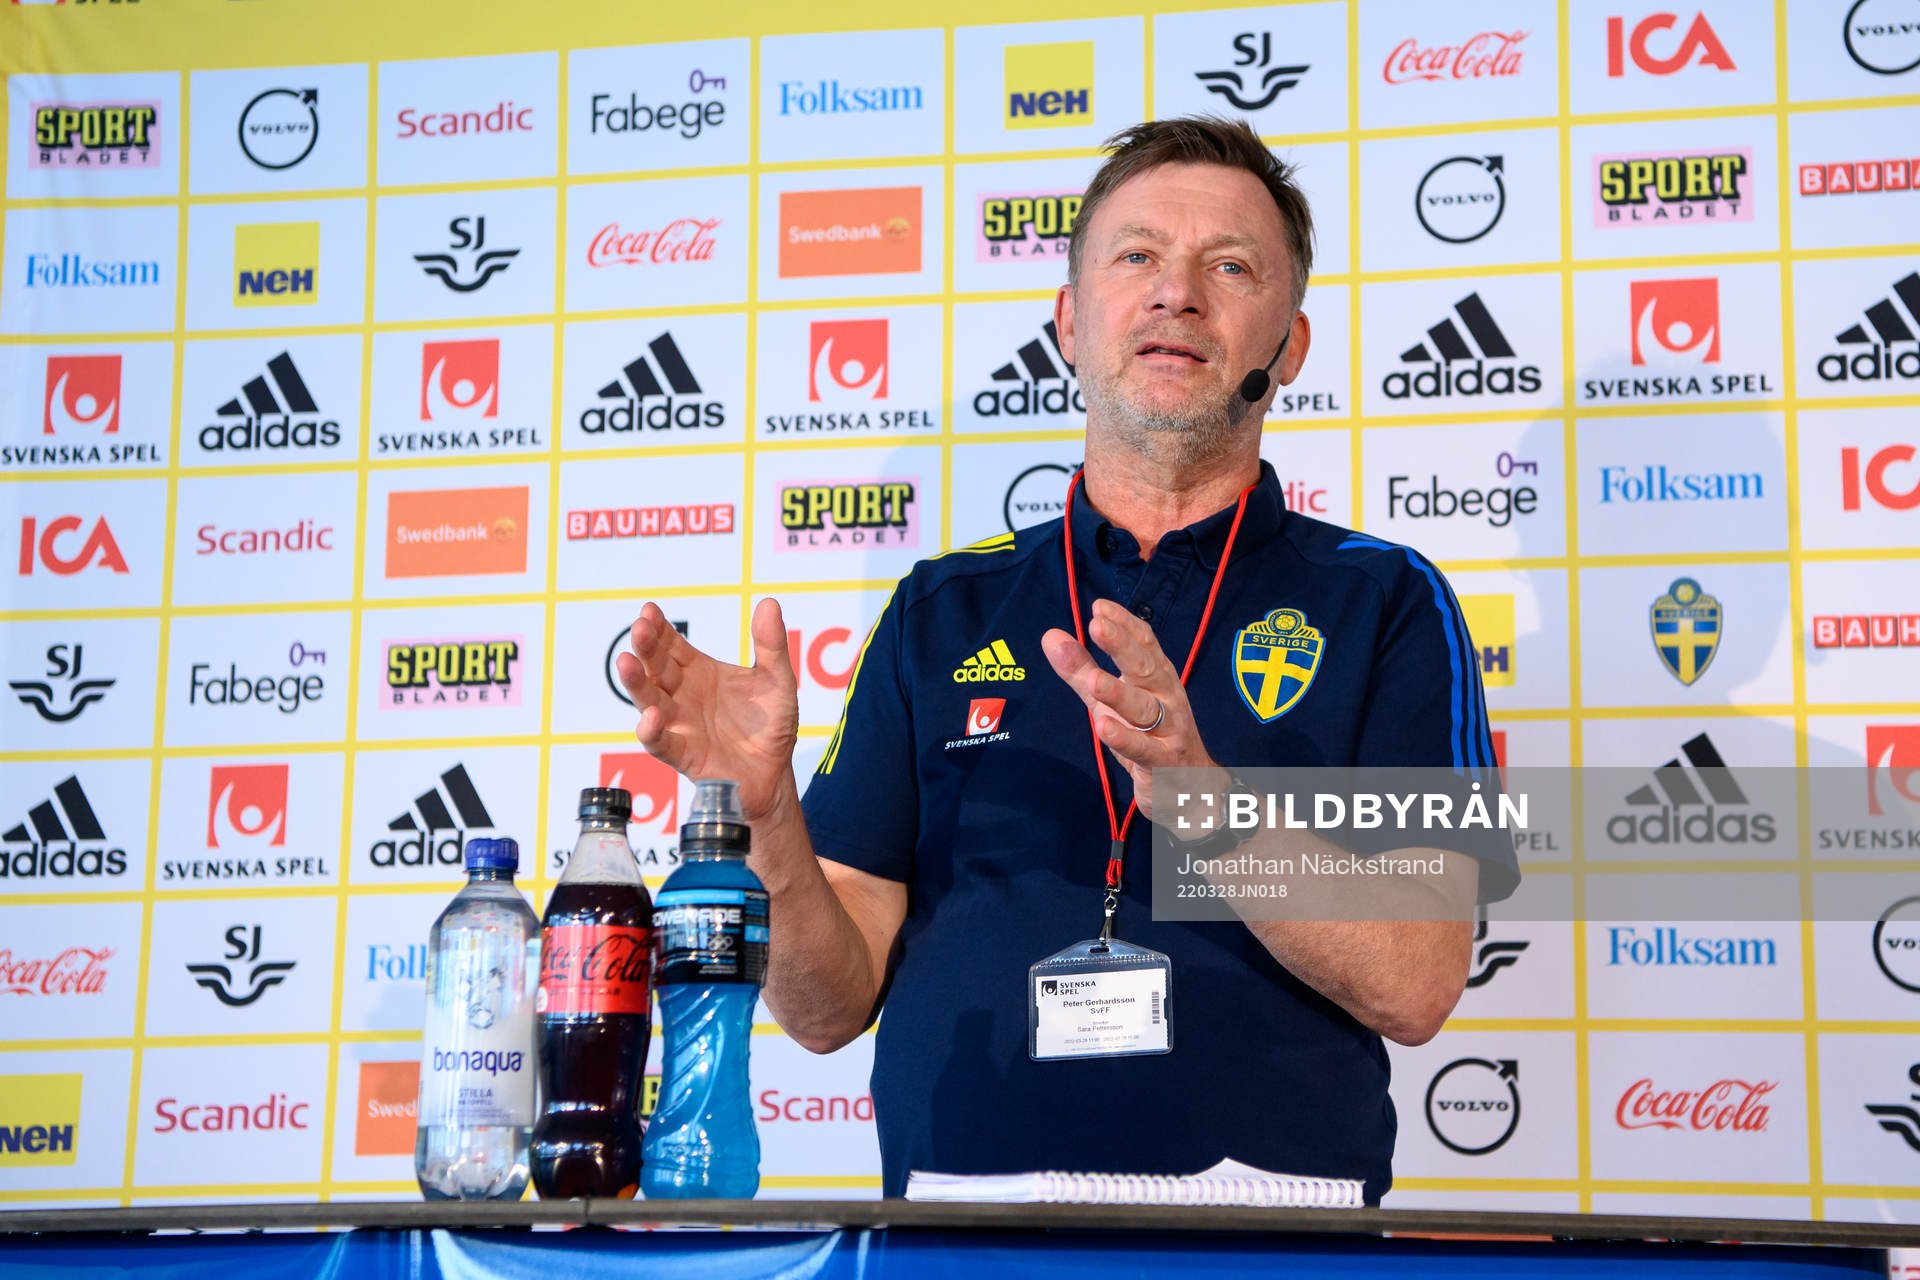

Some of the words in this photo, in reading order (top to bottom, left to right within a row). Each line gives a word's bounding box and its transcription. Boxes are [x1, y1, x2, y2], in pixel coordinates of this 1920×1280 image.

[1607, 12, 1737, 77] ICA
[1857, 24, 1920, 36] VOLV
[1233, 32, 1270, 67] SJ
[1383, 31, 1530, 85] Coca-Cola
[780, 80, 923, 116] Folksam
[36, 106, 156, 149] SPORT
[249, 124, 310, 135] VOLVO
[397, 102, 533, 138] Scandic
[591, 92, 725, 139] Fabege
[40, 150, 150, 164] BLADET
[1601, 155, 1746, 206] SPORT
[1802, 160, 1920, 192] BAUH
[1428, 193, 1495, 206] VOLVO
[1608, 204, 1740, 221] BLADET
[450, 217, 485, 250] SJ
[788, 224, 881, 244] Swedbank
[984, 195, 1082, 241] SPOR
[587, 218, 723, 267] Coca-Cola
[990, 242, 1068, 257] BLAD
[26, 253, 159, 287] Folksam
[1817, 344, 1920, 382] adid
[1382, 363, 1542, 399] adidas
[1585, 378, 1702, 399] SVENSKA
[1712, 375, 1773, 395] SPEL
[973, 381, 1086, 417] adid
[1283, 393, 1340, 413] SPEL
[580, 397, 724, 434] adidas
[766, 413, 871, 433] SVENSKA
[880, 410, 934, 429] SPEL
[199, 414, 340, 451] adidas
[378, 431, 480, 451] SVENSKA
[488, 428, 541, 447] SPEL
[2, 446, 101, 465] SVENSKA
[110, 444, 161, 463] SPEL
[1600, 466, 1764, 503] Folksam
[1841, 444, 1920, 511] IC
[782, 483, 914, 530] SPORT
[1015, 502, 1065, 512] VOLV
[1388, 475, 1538, 526] Fabege
[396, 523, 487, 544] Swedbank
[570, 505, 733, 537] BAUHAUS
[19, 515, 129, 576] ICA
[197, 520, 333, 555] Scandic
[788, 530, 908, 546] BLADET
[1252, 635, 1310, 648] SVERIGE
[1816, 618, 1920, 645] BAUH
[46, 644, 82, 679] SJ
[388, 641, 518, 688] SPORT
[788, 626, 858, 690] IC
[953, 664, 1026, 683] adidas
[190, 662, 325, 713] Fabege
[393, 687, 511, 704] BLADET
[944, 738, 986, 750] SVENSKA
[987, 731, 1011, 744] SPEL
[1606, 805, 1776, 844] adidas
[1819, 829, 1920, 849] SVENSK
[370, 838, 463, 867] adid
[1515, 832, 1559, 852] PEL
[163, 860, 267, 880] SVENSKA
[275, 857, 330, 877] SPEL
[225, 925, 262, 962] SJ
[1608, 927, 1777, 966] Folksam
[1060, 980, 1097, 989] SVENSKA
[1060, 988, 1079, 996] SPEL
[1063, 1000, 1083, 1008] Peter
[1085, 997, 1136, 1007] Gerhardsson
[1090, 1006, 1111, 1015] SvFF
[433, 1047, 524, 1077] bonaqua
[153, 1093, 310, 1134] Scandic
[368, 1098, 417, 1119] Swed
[759, 1089, 875, 1122] Scand
[1437, 1100, 1510, 1112] VOLVO
[1616, 1078, 1779, 1133] Coca-Cola
